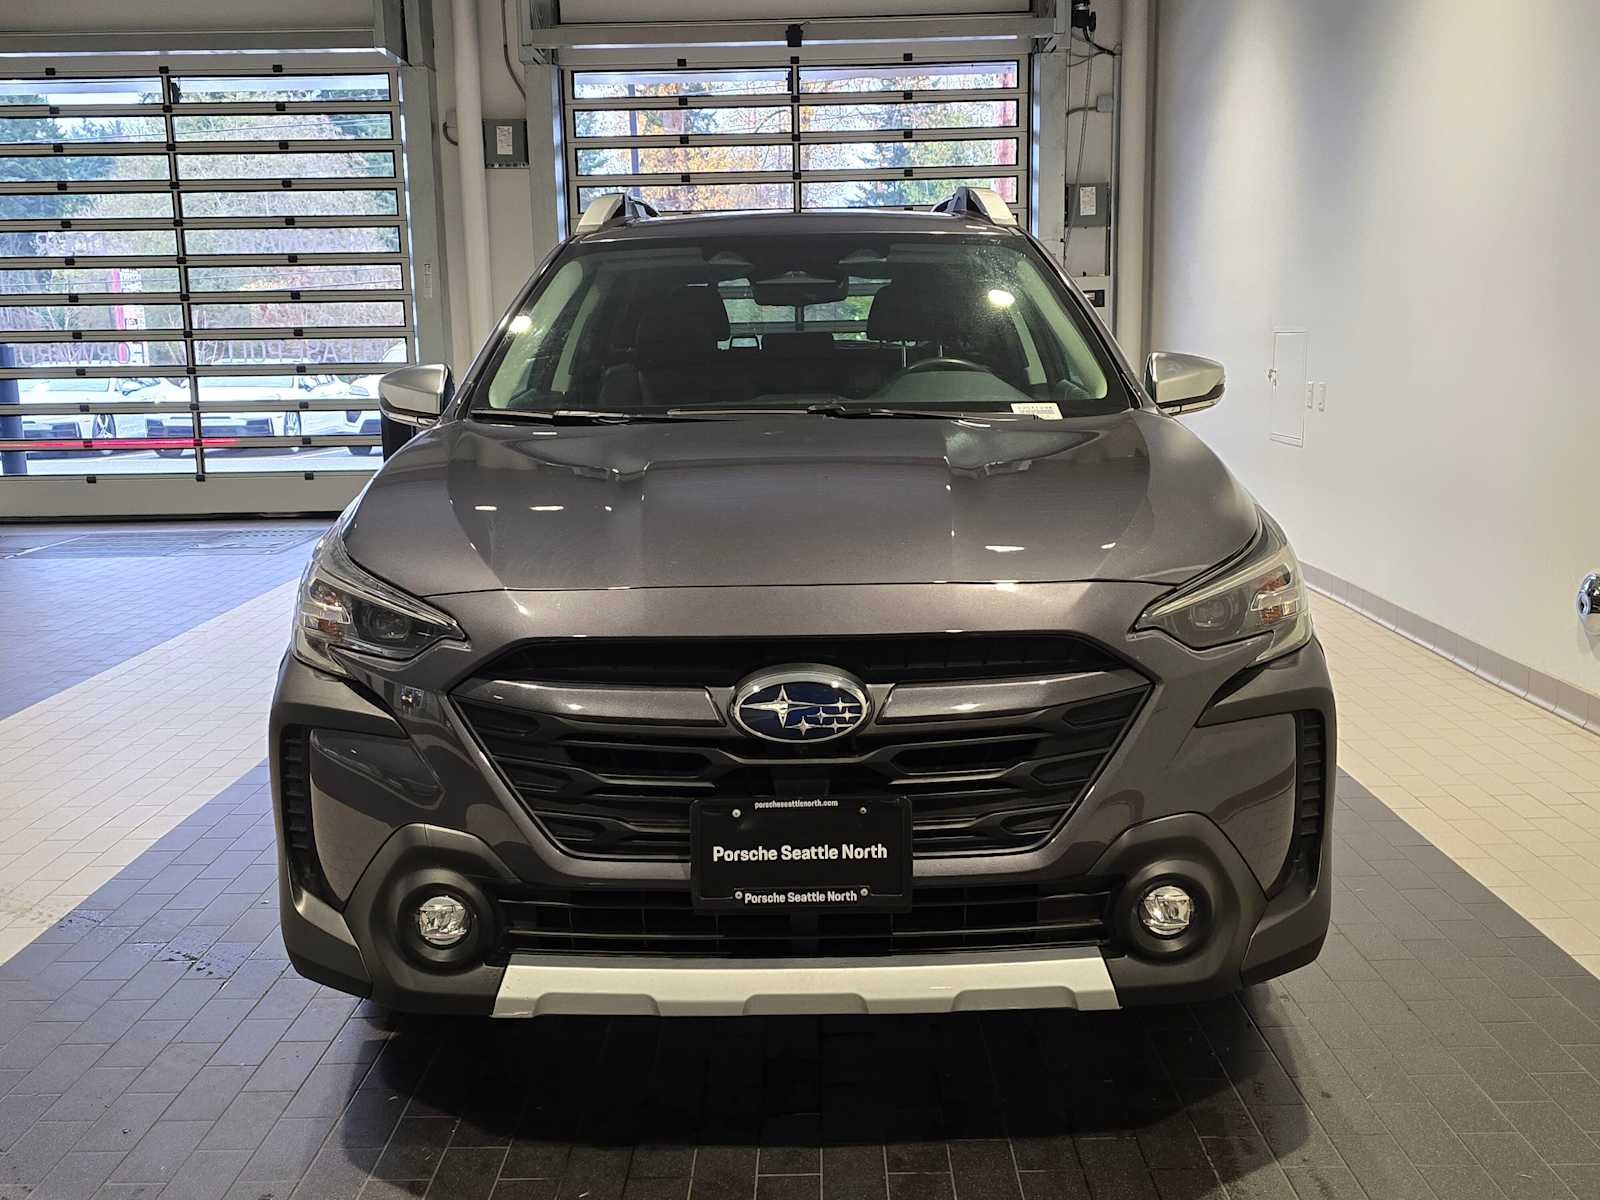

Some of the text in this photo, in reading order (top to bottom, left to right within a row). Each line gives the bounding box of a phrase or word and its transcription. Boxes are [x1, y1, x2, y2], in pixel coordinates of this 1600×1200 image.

[754, 799, 838, 809] porscheseattlenorth.com
[713, 843, 888, 862] Porsche Seattle North
[744, 890, 858, 904] Porsche Seattle North
